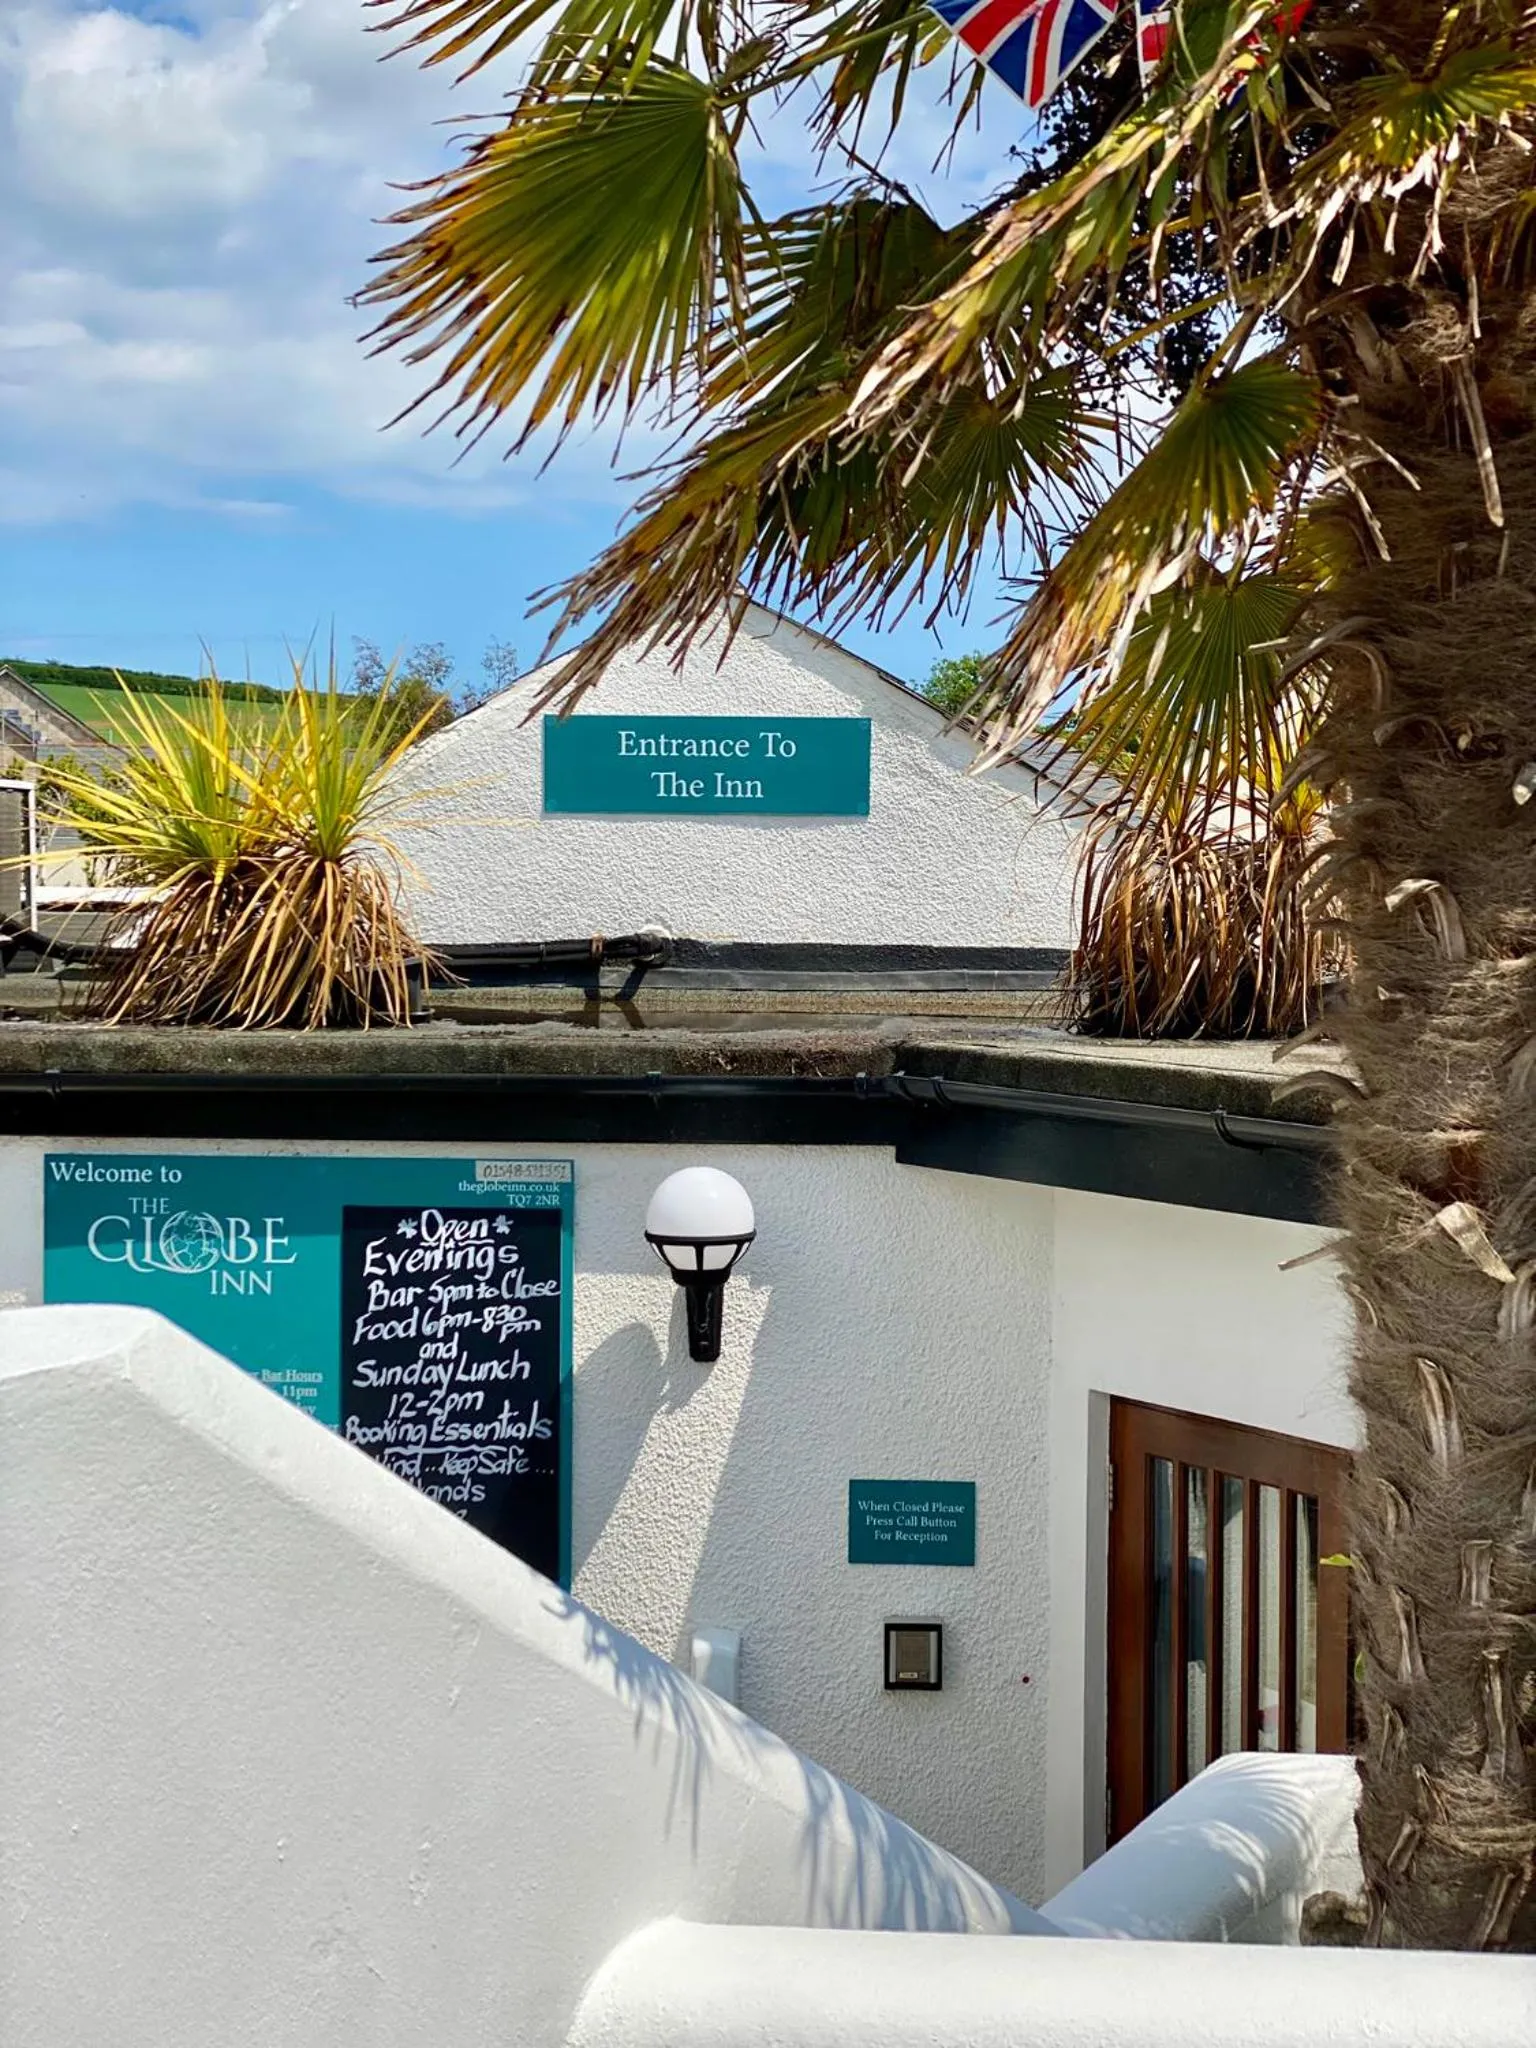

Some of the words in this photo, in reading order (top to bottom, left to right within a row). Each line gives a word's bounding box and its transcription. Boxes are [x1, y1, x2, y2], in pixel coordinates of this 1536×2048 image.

[617, 730, 750, 757] Entrance
[759, 732, 797, 757] To
[651, 771, 705, 797] The
[713, 772, 764, 798] Inn
[50, 1162, 153, 1183] Welcome
[160, 1165, 183, 1184] to
[458, 1180, 560, 1194] theglobeinn.co.uk
[506, 1194, 532, 1207] TQ7
[535, 1194, 560, 1206] 2NR
[128, 1197, 171, 1215] THE
[87, 1211, 298, 1274] GLOBE
[420, 1209, 489, 1256] Open
[363, 1237, 520, 1281] Evenings
[210, 1270, 273, 1296] INN
[368, 1279, 424, 1312] Bar
[428, 1274, 474, 1315] 5pm
[475, 1281, 500, 1299] to
[501, 1267, 562, 1300] Close
[353, 1306, 419, 1345] Food
[419, 1331, 460, 1359] and
[261, 1369, 283, 1382] Bar
[285, 1369, 324, 1383] Hours
[352, 1359, 454, 1394] Sunday
[455, 1349, 531, 1383] Lunch
[388, 1389, 485, 1424] 12-2pm
[430, 1400, 554, 1443] Essentials
[438, 1452, 478, 1483] Keep
[858, 1501, 890, 1512] When
[893, 1501, 929, 1513] Closed
[931, 1502, 966, 1514] Please
[866, 1515, 894, 1526] Press
[896, 1516, 918, 1527] Call
[920, 1516, 957, 1528] Button
[875, 1530, 892, 1540] For
[895, 1530, 948, 1544] Reception
